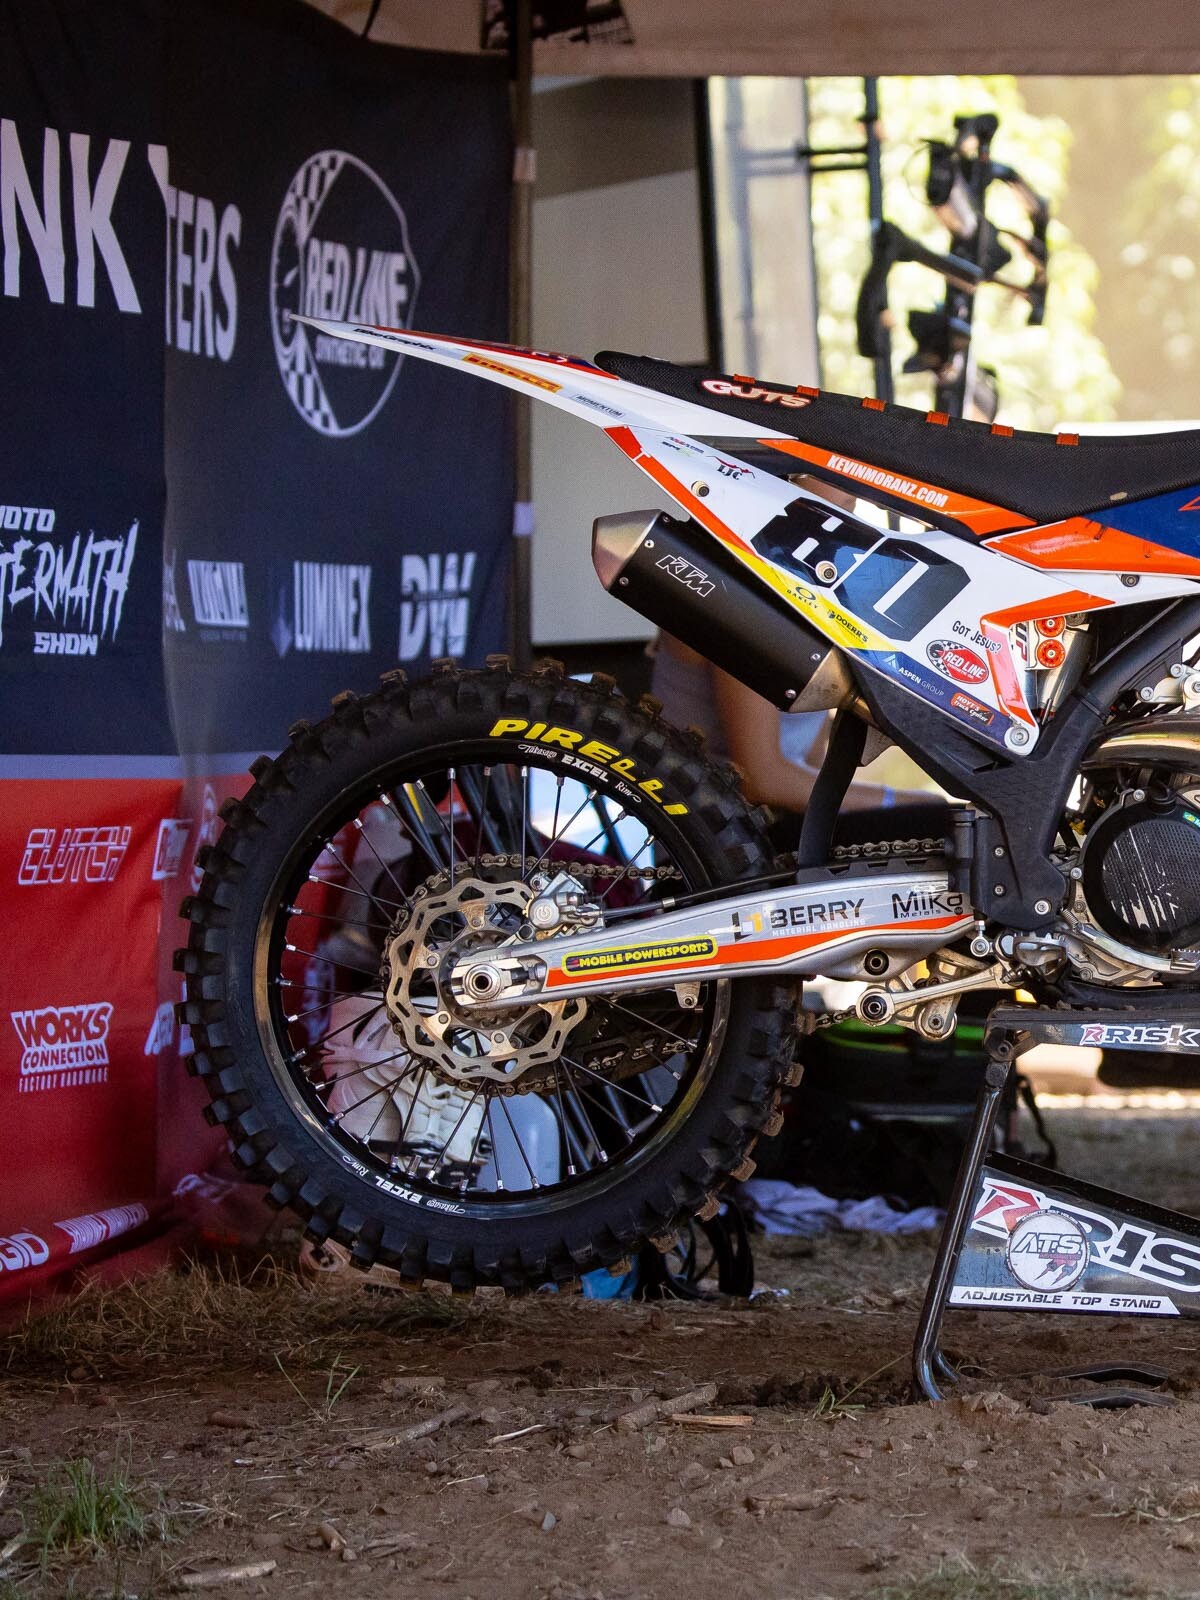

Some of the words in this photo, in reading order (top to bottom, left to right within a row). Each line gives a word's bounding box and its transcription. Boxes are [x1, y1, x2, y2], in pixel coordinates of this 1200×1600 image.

[304, 237, 350, 321] RED
[346, 247, 407, 329] LINE
[701, 380, 812, 408] GUTS
[826, 454, 949, 508] KEVINMORANZ.COM
[0, 505, 55, 533] OTO
[655, 554, 717, 598] KTM
[836, 614, 869, 643] DOERR'S
[952, 620, 972, 638] GOT
[970, 630, 1002, 654] JESUS?
[34, 631, 98, 656] SHOW
[943, 651, 966, 668] RED
[961, 658, 987, 679] LINE
[898, 666, 921, 684] ASPEN
[920, 681, 945, 697] GROUP
[489, 719, 689, 815] PIRELLI
[561, 754, 609, 783] EXCEL
[615, 781, 642, 803] Rim
[770, 898, 865, 929] BERRY
[772, 924, 816, 937] MATERIAL
[900, 908, 941, 919] Metals
[579, 952, 623, 967] MOBILE
[624, 941, 708, 962] POWERSPORTS
[11, 1003, 113, 1050] WORKS
[22, 1044, 108, 1074] CONNECTION
[342, 1155, 369, 1177] Rim
[375, 1175, 422, 1204] EXCEL
[961, 1289, 1063, 1304] ADJUSTABLE
[1072, 1295, 1102, 1306] TOP
[1109, 1297, 1162, 1309] STAND
